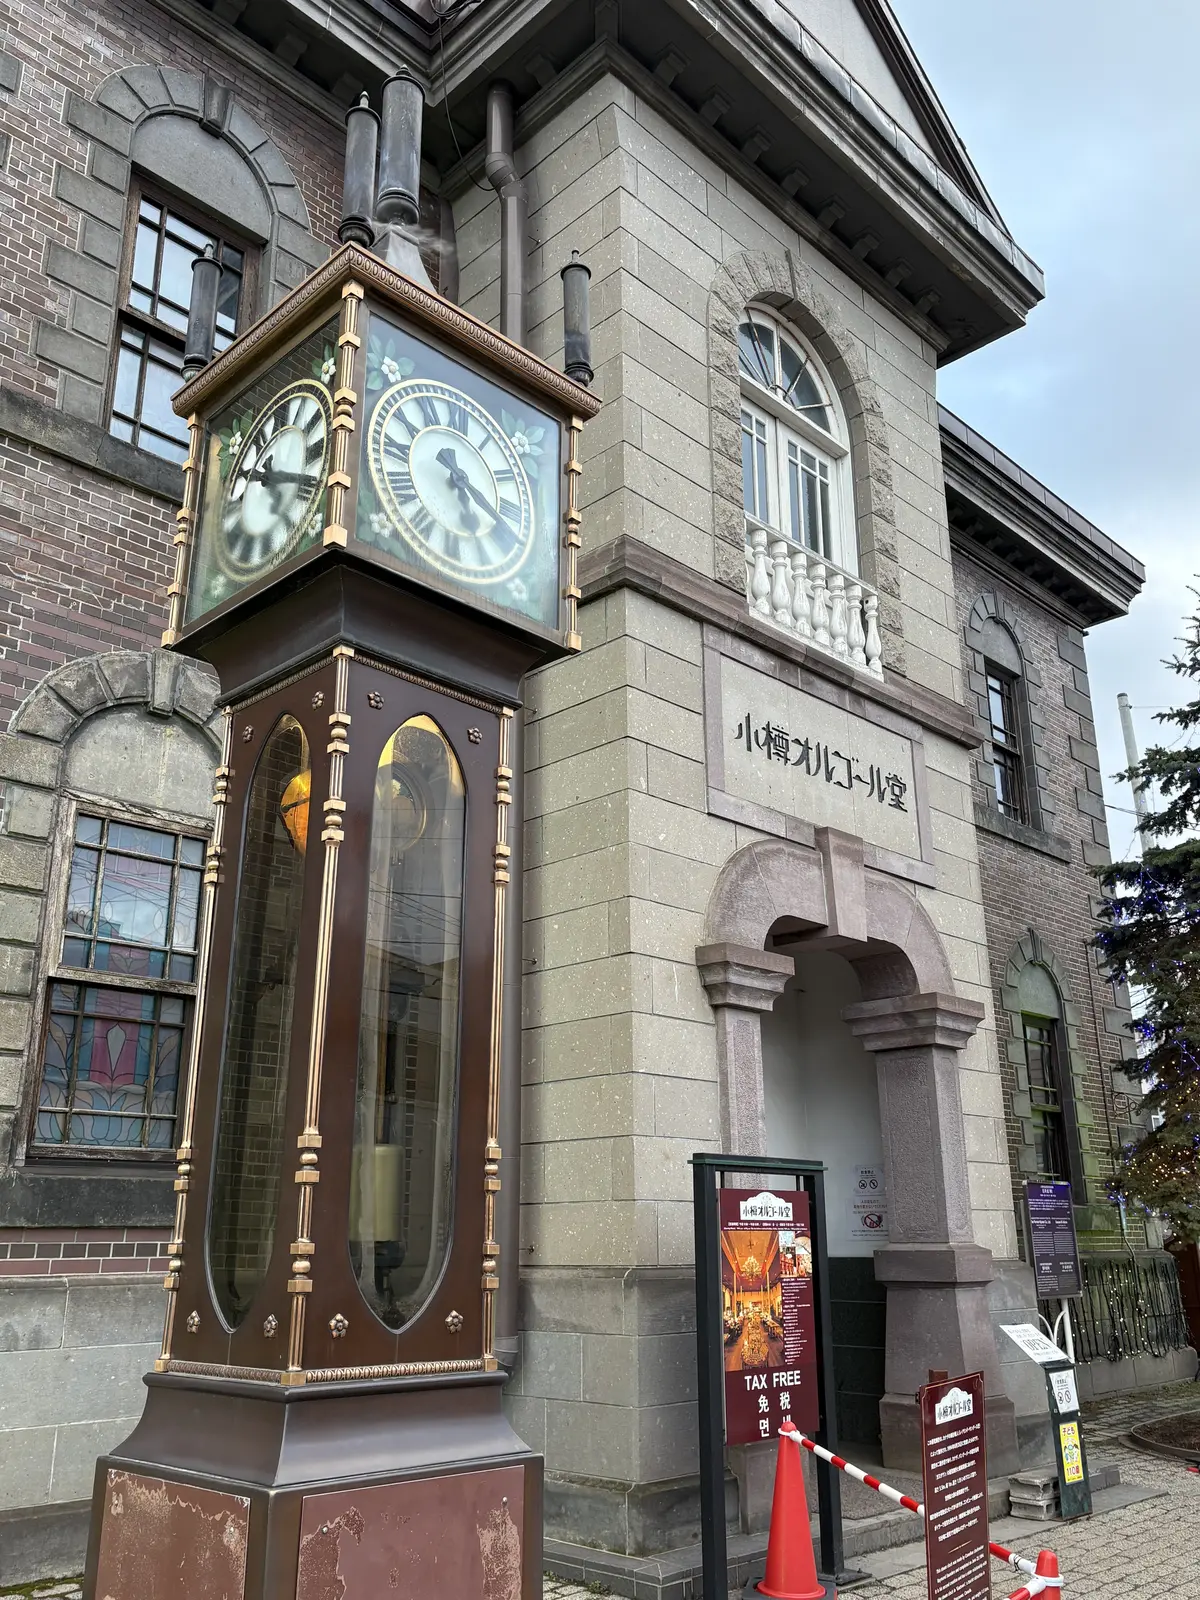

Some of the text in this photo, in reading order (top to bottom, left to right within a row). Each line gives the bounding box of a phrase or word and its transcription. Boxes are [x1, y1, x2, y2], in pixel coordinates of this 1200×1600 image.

[734, 711, 909, 814] 小樽オルゴール堂
[744, 1370, 801, 1391] TAX FREE
